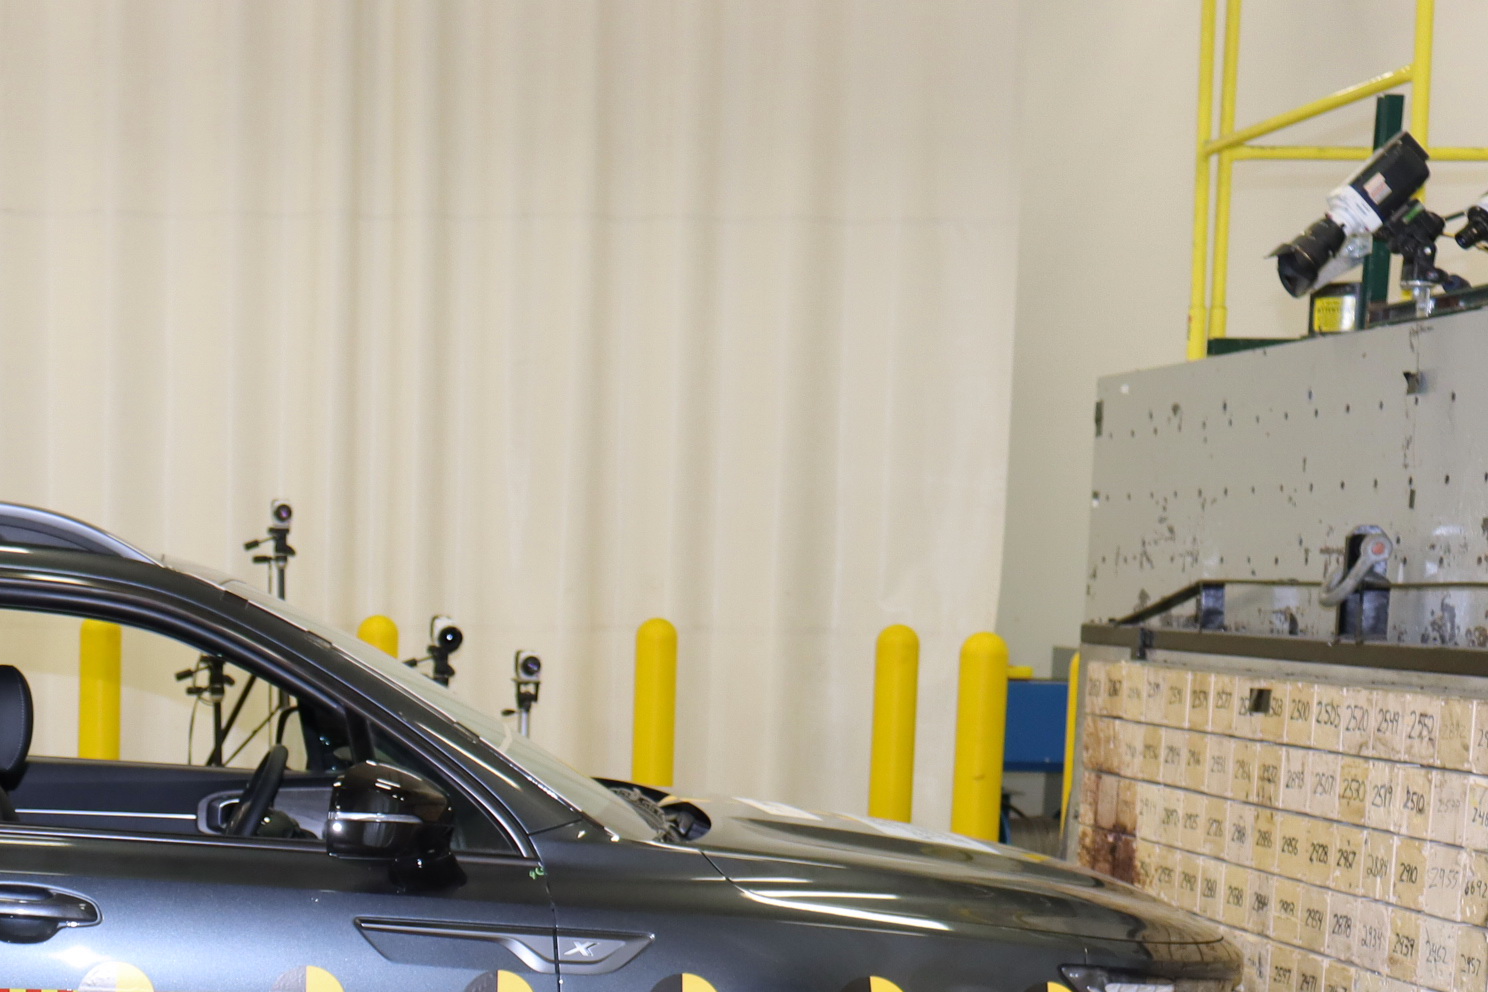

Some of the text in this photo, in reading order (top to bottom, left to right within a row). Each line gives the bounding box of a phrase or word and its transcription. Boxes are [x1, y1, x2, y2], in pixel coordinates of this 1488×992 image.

[1290, 699, 1310, 721] 2500
[1316, 700, 1341, 729] 2505
[1361, 924, 1383, 950] 2934
